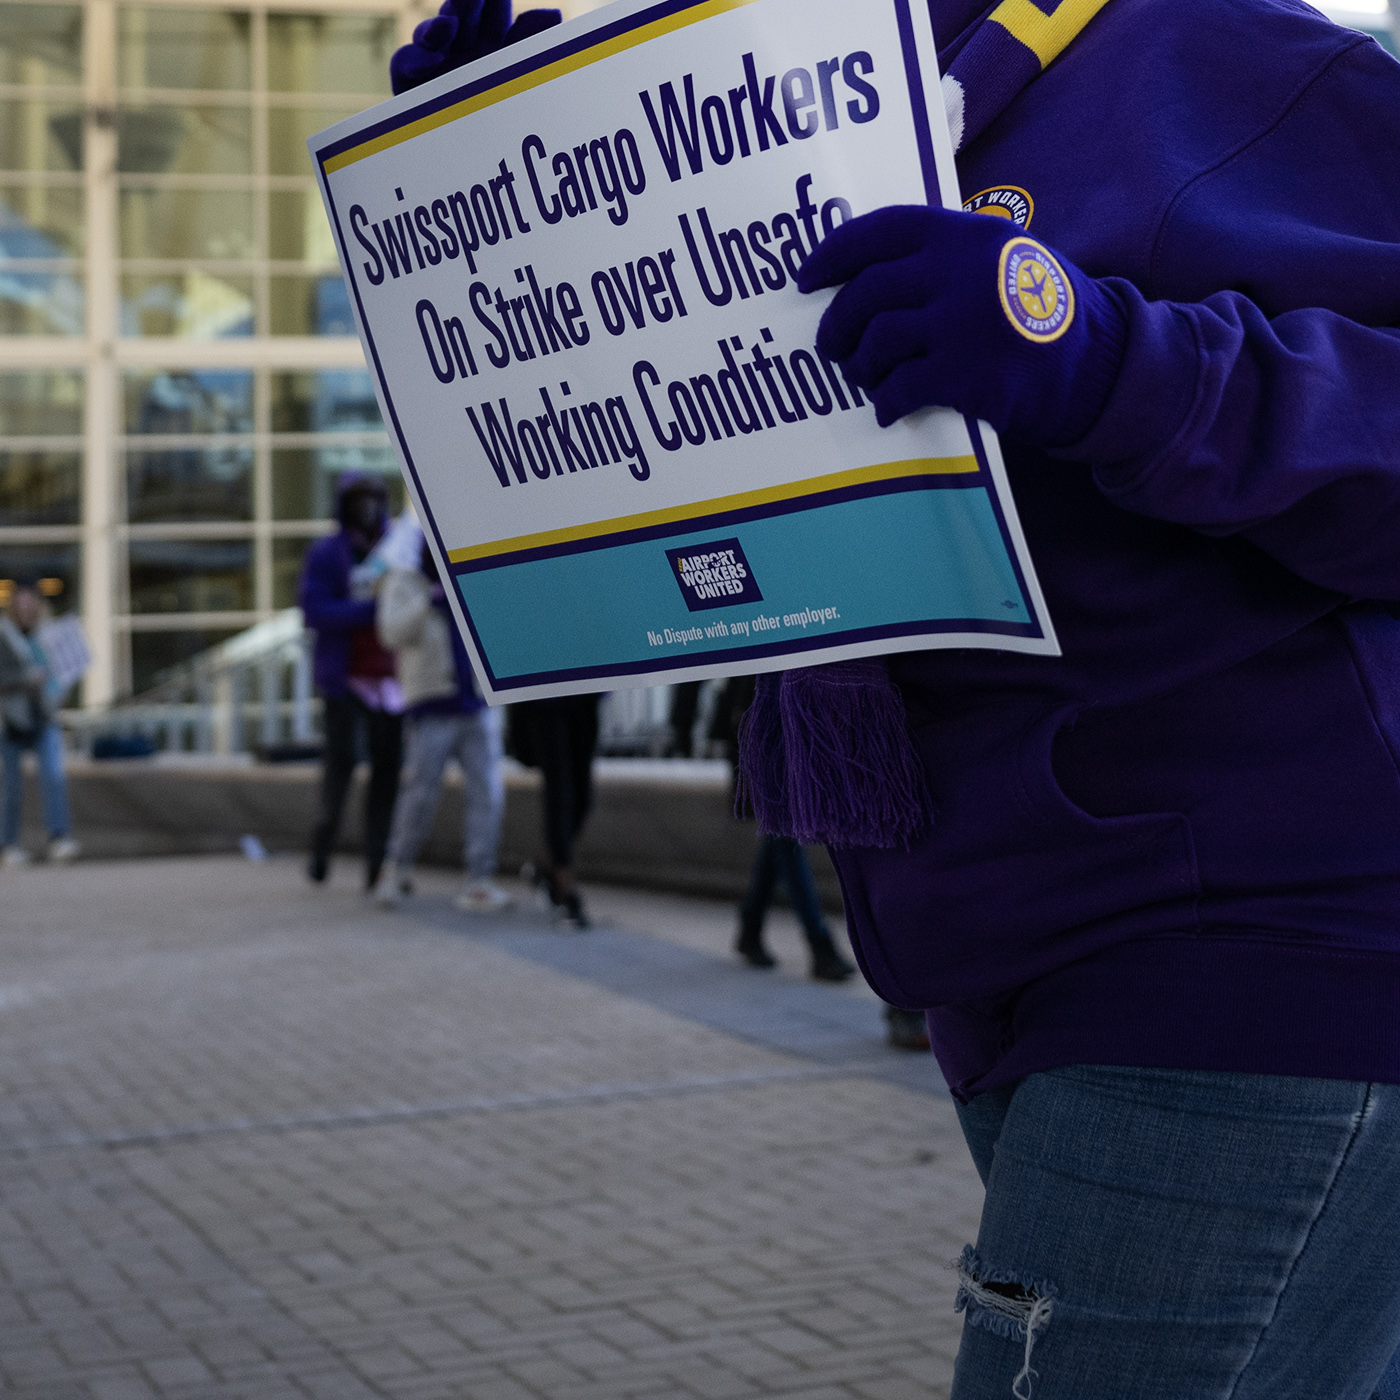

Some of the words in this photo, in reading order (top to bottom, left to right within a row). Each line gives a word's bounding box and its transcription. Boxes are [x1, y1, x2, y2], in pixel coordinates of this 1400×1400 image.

[348, 157, 532, 286] Swissport
[521, 128, 647, 227] Cargo
[638, 50, 881, 183] Workers
[987, 191, 1027, 225] WORKER
[1008, 253, 1022, 296] UNITED
[1035, 252, 1066, 302] AIRPORT
[415, 298, 480, 384] On
[468, 264, 591, 369] Strike
[590, 247, 689, 337] over
[1025, 303, 1066, 331] WORKERS
[464, 380, 651, 488] Working
[632, 326, 866, 452] Condition
[680, 563, 747, 587] WORKERS
[681, 549, 737, 573] AIRPORT
[694, 579, 744, 600] UNITED
[647, 630, 663, 646] No
[665, 626, 704, 646] Dispute
[704, 621, 729, 639] with
[730, 620, 750, 636] any
[752, 614, 781, 632] other
[783, 606, 841, 629] employer.
